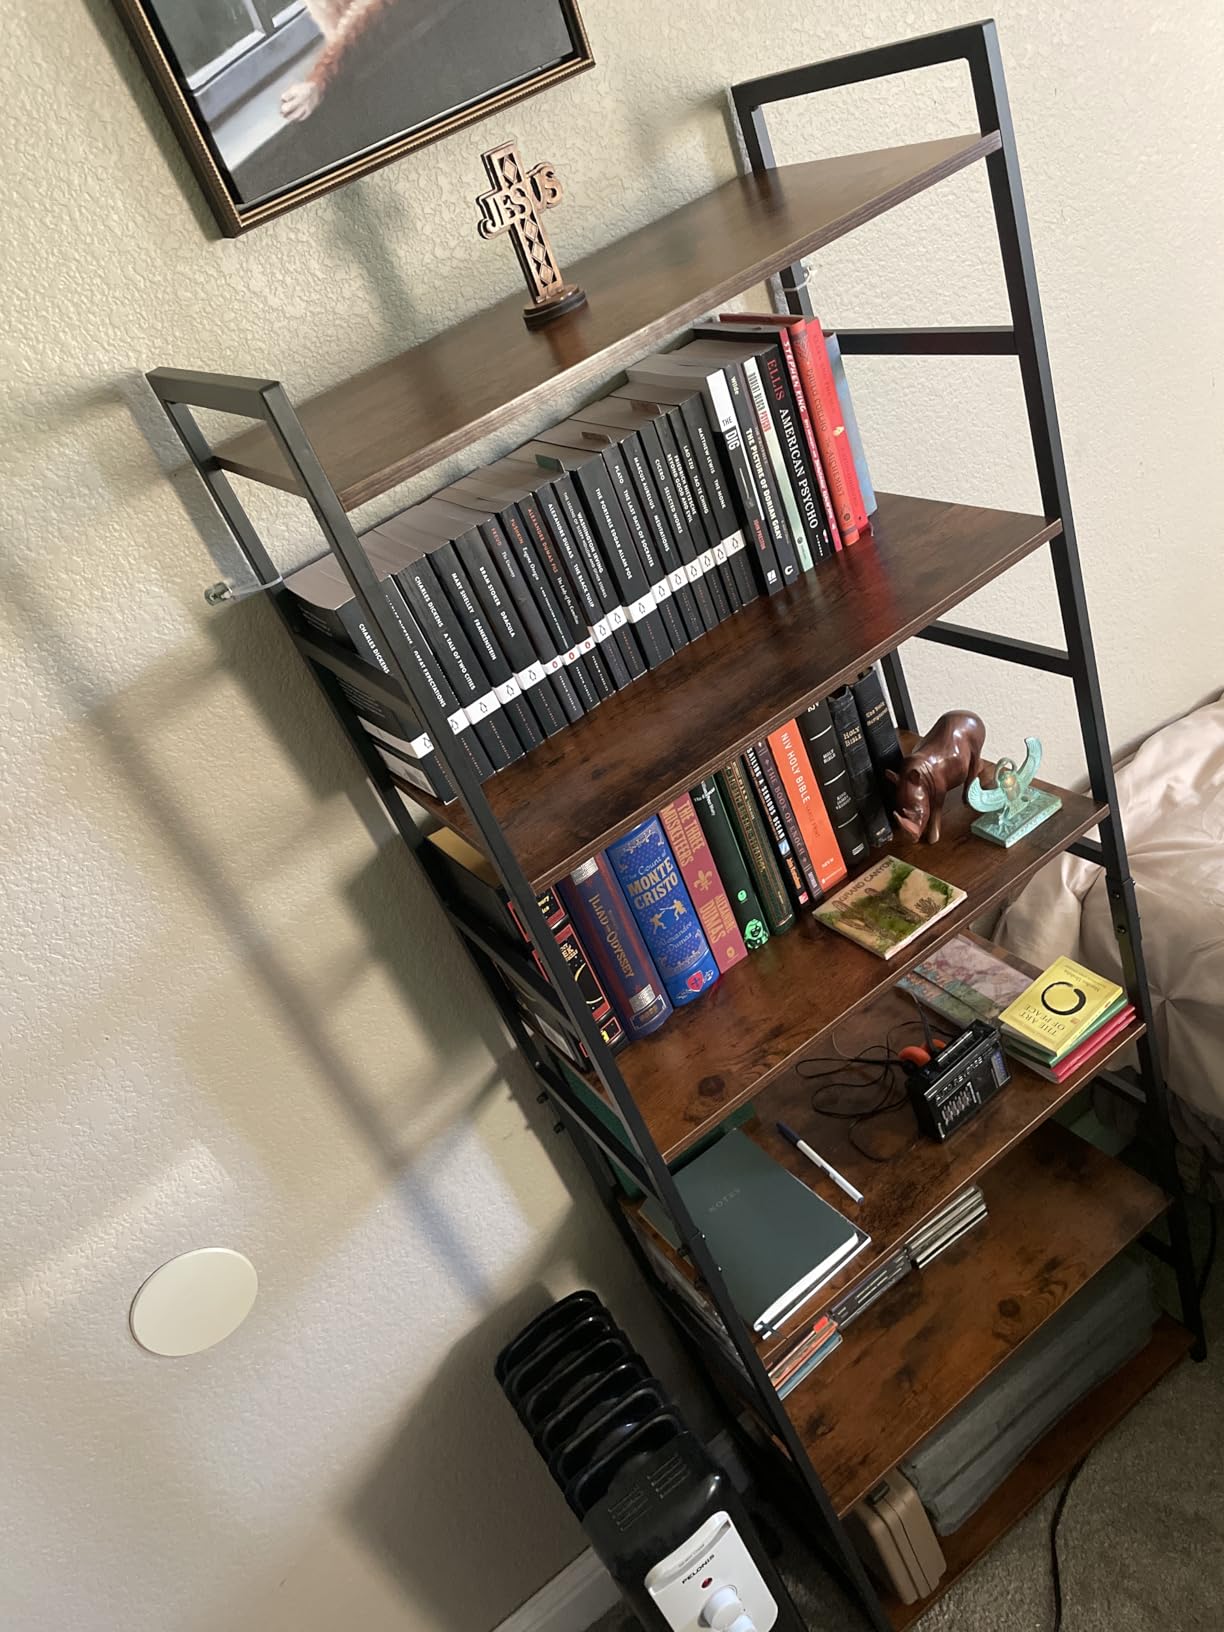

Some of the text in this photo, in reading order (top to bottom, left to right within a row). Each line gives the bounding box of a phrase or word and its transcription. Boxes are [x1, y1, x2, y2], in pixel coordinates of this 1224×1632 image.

[479, 163, 563, 239] JESUS
[729, 376, 740, 395] Wilde
[782, 340, 806, 412] STEPHEN KING
[721, 417, 733, 426] THE
[724, 429, 740, 450] DIG
[766, 358, 785, 401] ELLIS
[778, 407, 806, 479] AMERICAN
[797, 479, 819, 529] PSYCHO
[813, 397, 828, 432] COELHO
[654, 458, 683, 533] CICERO SELECTED WORKS
[666, 453, 678, 477] BEYOND
[674, 478, 684, 496] GOOD
[685, 510, 693, 522] EVIL
[673, 454, 696, 514] FRIEDRICH NIETZSCHE
[682, 445, 690, 457] LAO
[686, 457, 694, 469] TZU
[692, 475, 700, 487] TAO
[698, 494, 709, 513] CHING
[696, 427, 709, 455] MATTHEW
[705, 455, 715, 474] LEWIS
[716, 490, 726, 508] MONK
[744, 427, 783, 540] THE PICTURE OF DORIAN GRAY
[826, 450, 844, 497] ALCHEMIST
[509, 517, 524, 544] PUSHKIN
[594, 487, 602, 499] THE
[599, 500, 613, 528] PORTABLE
[609, 529, 621, 548] EDGAR
[617, 548, 628, 567] ALLAN
[614, 465, 654, 566] PLATO THE LAST DAYS OF SOCRATES
[632, 456, 670, 551] MARCUS AURELIUS MEDITATIONS
[527, 507, 544, 541] ALEXANDRE
[541, 541, 554, 562] DUMAS
[547, 502, 594, 608] ALEXANDRE DUMAS THE BLACK TULIP
[576, 511, 604, 573] WASHINGTON IRVING
[413, 575, 431, 602] CHARLES
[427, 601, 443, 627] DICKENS
[445, 637, 456, 651] TALE
[452, 650, 460, 659] OF
[456, 658, 467, 673] TWO
[463, 672, 476, 690] CITIES
[451, 572, 497, 660] MARY SHELLEY FRANKENSTEIN
[478, 566, 515, 638] BRAM STOKER DRACULA
[357, 622, 390, 674] CHARLES DICKENS
[422, 667, 446, 708] EXPECTATIONS
[745, 746, 763, 777] SAILING
[760, 786, 776, 816] SERIOUS
[771, 816, 785, 840] OCEAN
[779, 732, 811, 804] NIV HOLY BIBLE
[658, 802, 696, 867] MUSKETEERS
[675, 800, 695, 823] THE
[682, 819, 706, 852] THREE
[765, 766, 778, 785] THE
[773, 786, 787, 809] BOOK
[783, 812, 792, 824] OF
[788, 825, 805, 855] ENOCH
[627, 857, 675, 896] MONTE
[634, 872, 680, 909] CRISTO
[638, 857, 662, 874] Count
[863, 859, 894, 883] CANYON
[587, 881, 638, 979] ILIAD ODYSSEY
[697, 898, 728, 944] DUMAS
[713, 894, 737, 933] ALEXANDRE
[1018, 1012, 1057, 1036] THE ART
[1023, 1004, 1065, 1031] OF PEACE
[681, 1553, 715, 1585] PELONIS
